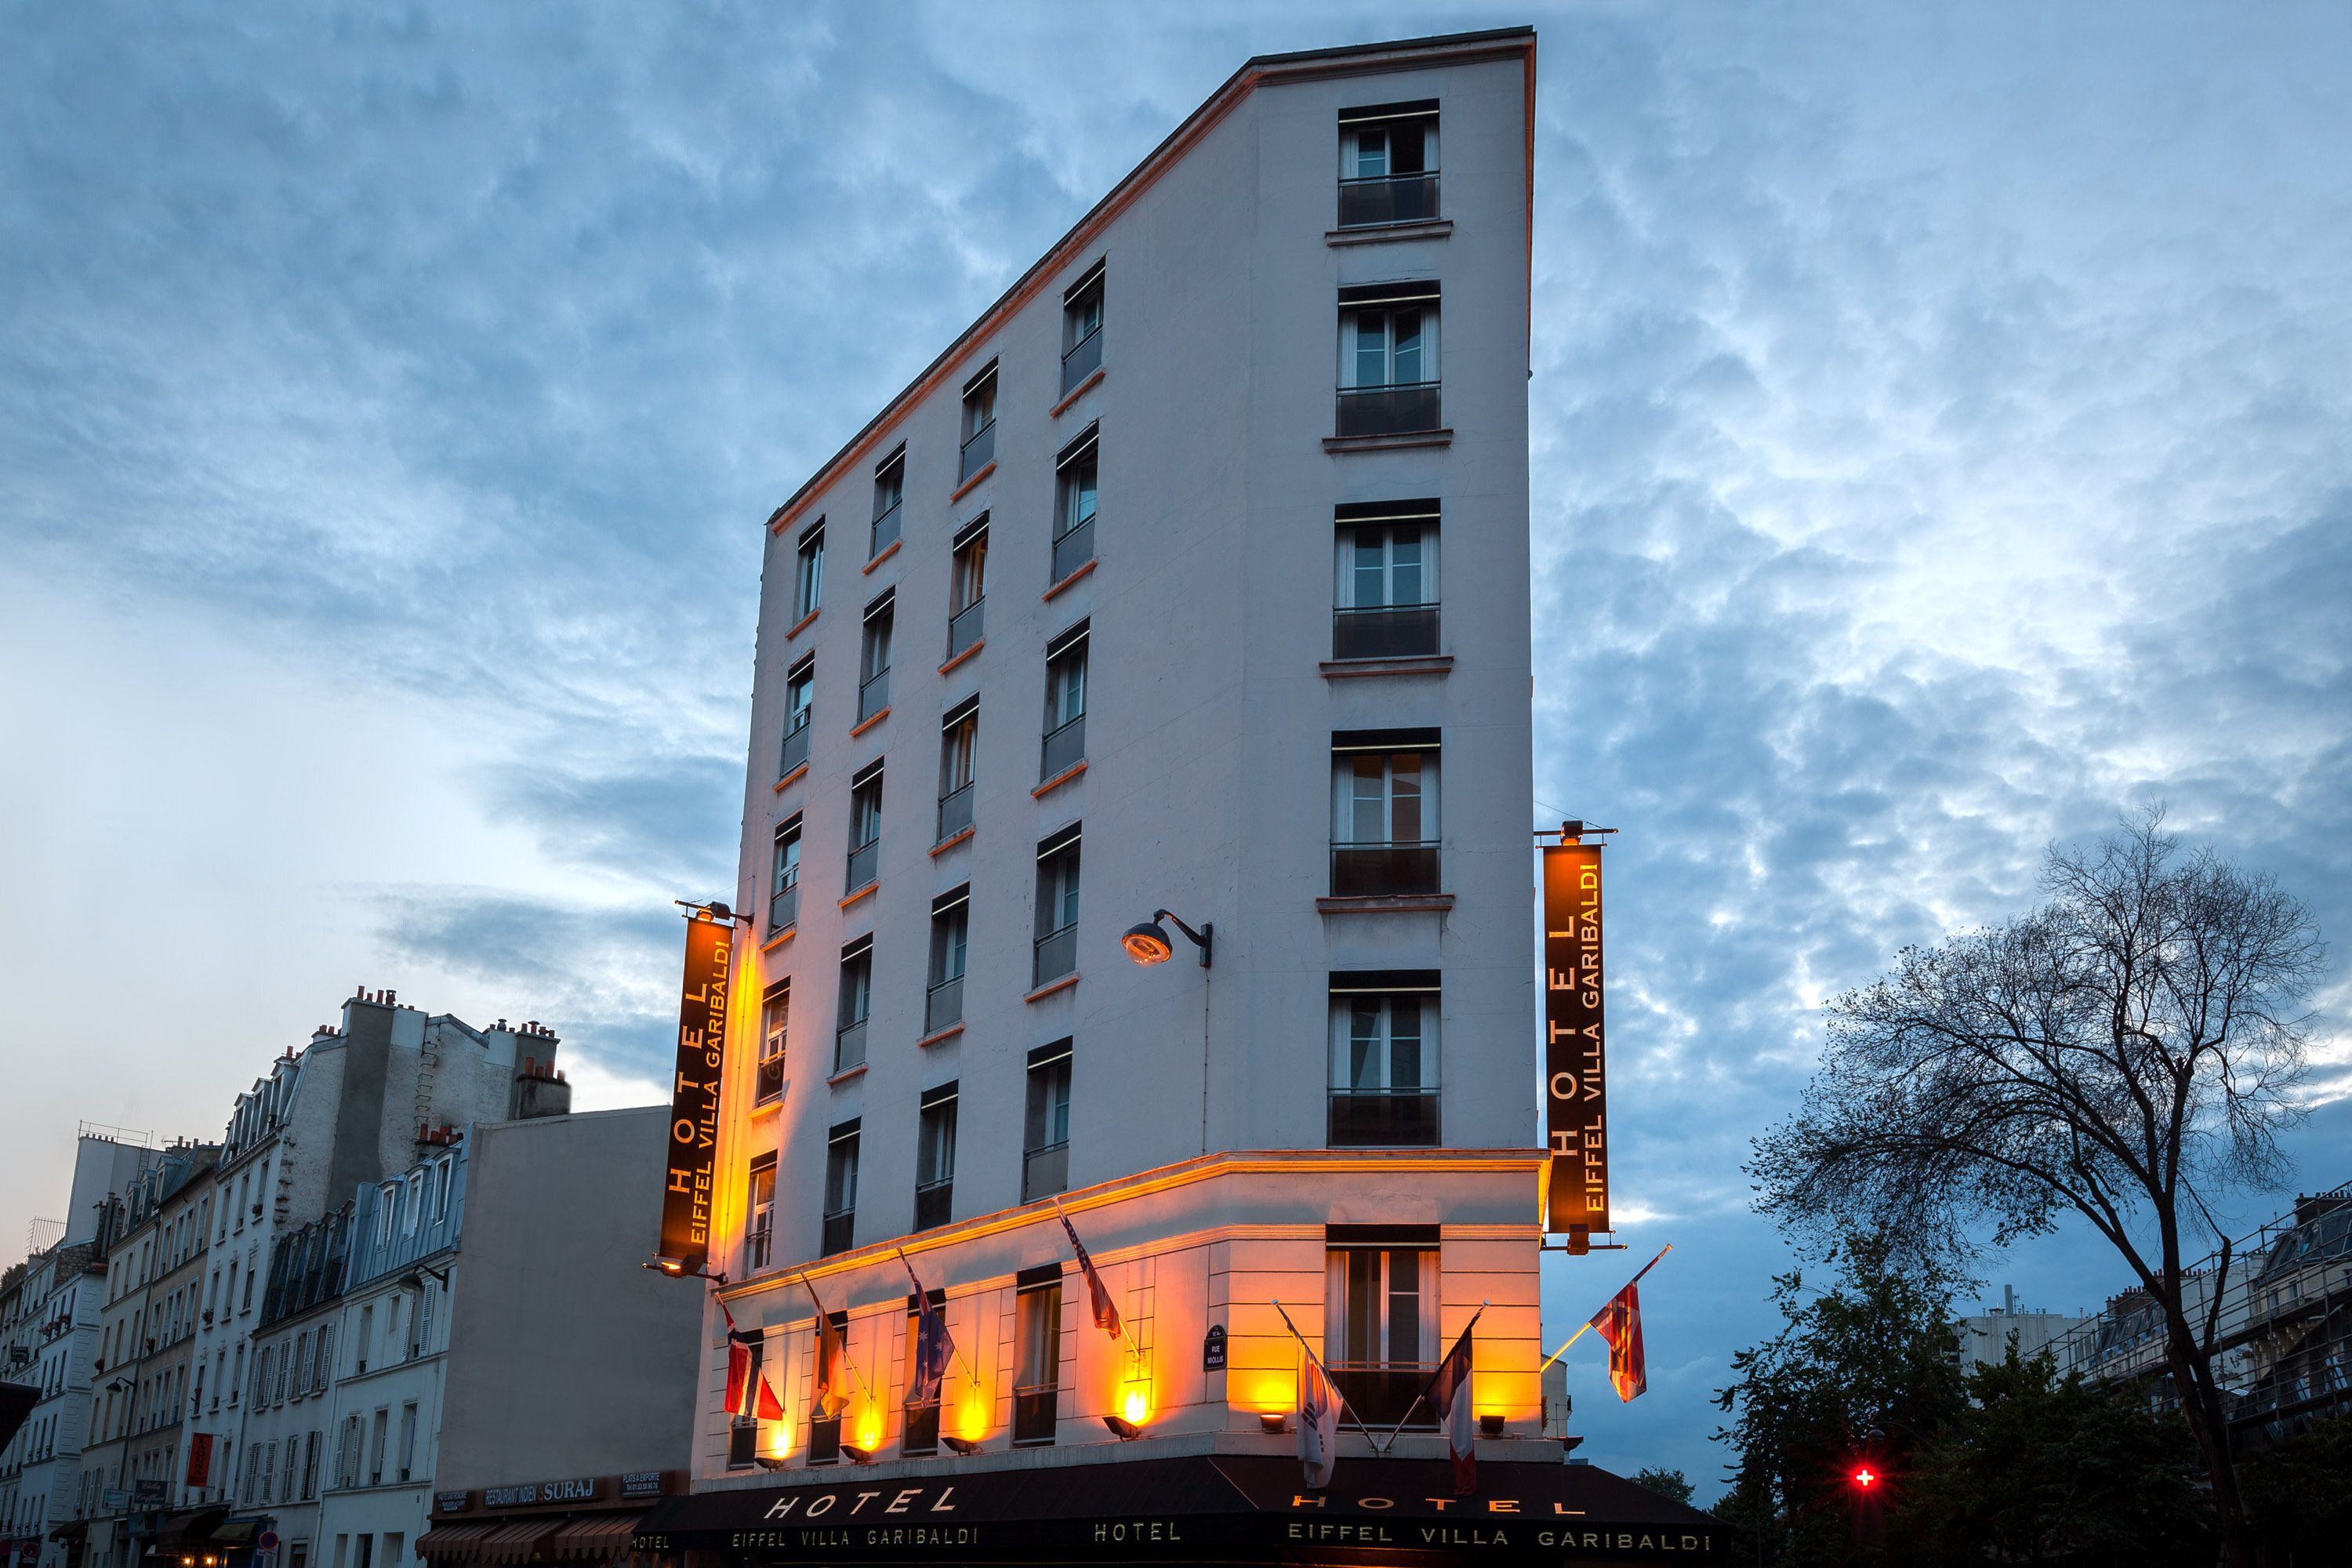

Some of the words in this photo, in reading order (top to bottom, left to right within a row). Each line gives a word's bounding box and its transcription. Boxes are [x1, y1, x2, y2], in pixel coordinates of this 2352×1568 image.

[1580, 864, 1600, 1010] GARIBALDI
[706, 940, 730, 1067] GARIBALDI
[1549, 916, 1578, 1156] HOTEL
[1582, 1022, 1602, 1102] VILLA
[669, 982, 707, 1194] HOTEL
[699, 1080, 719, 1149] VILLA
[1585, 1114, 1605, 1213] EIFFEL
[691, 1160, 712, 1245] EIFFEL
[1207, 1356, 1224, 1364] MIOLLIS
[1211, 1345, 1221, 1353] RUE
[485, 1487, 518, 1506] RESTAURANT
[518, 1485, 537, 1504] INDIEN
[543, 1479, 594, 1501] SURAJ
[763, 1486, 956, 1519] HOTEL
[1292, 1495, 1586, 1515] HOTEL
[732, 1533, 786, 1548] EIFFEL
[801, 1530, 849, 1546] VILLA
[867, 1527, 978, 1544] GARIBALDI
[1094, 1522, 1181, 1542] HOTEL
[1288, 1523, 1393, 1542] EIFFEL
[1421, 1528, 1508, 1545] VILLA
[1537, 1531, 1711, 1551] GARIBALDI
